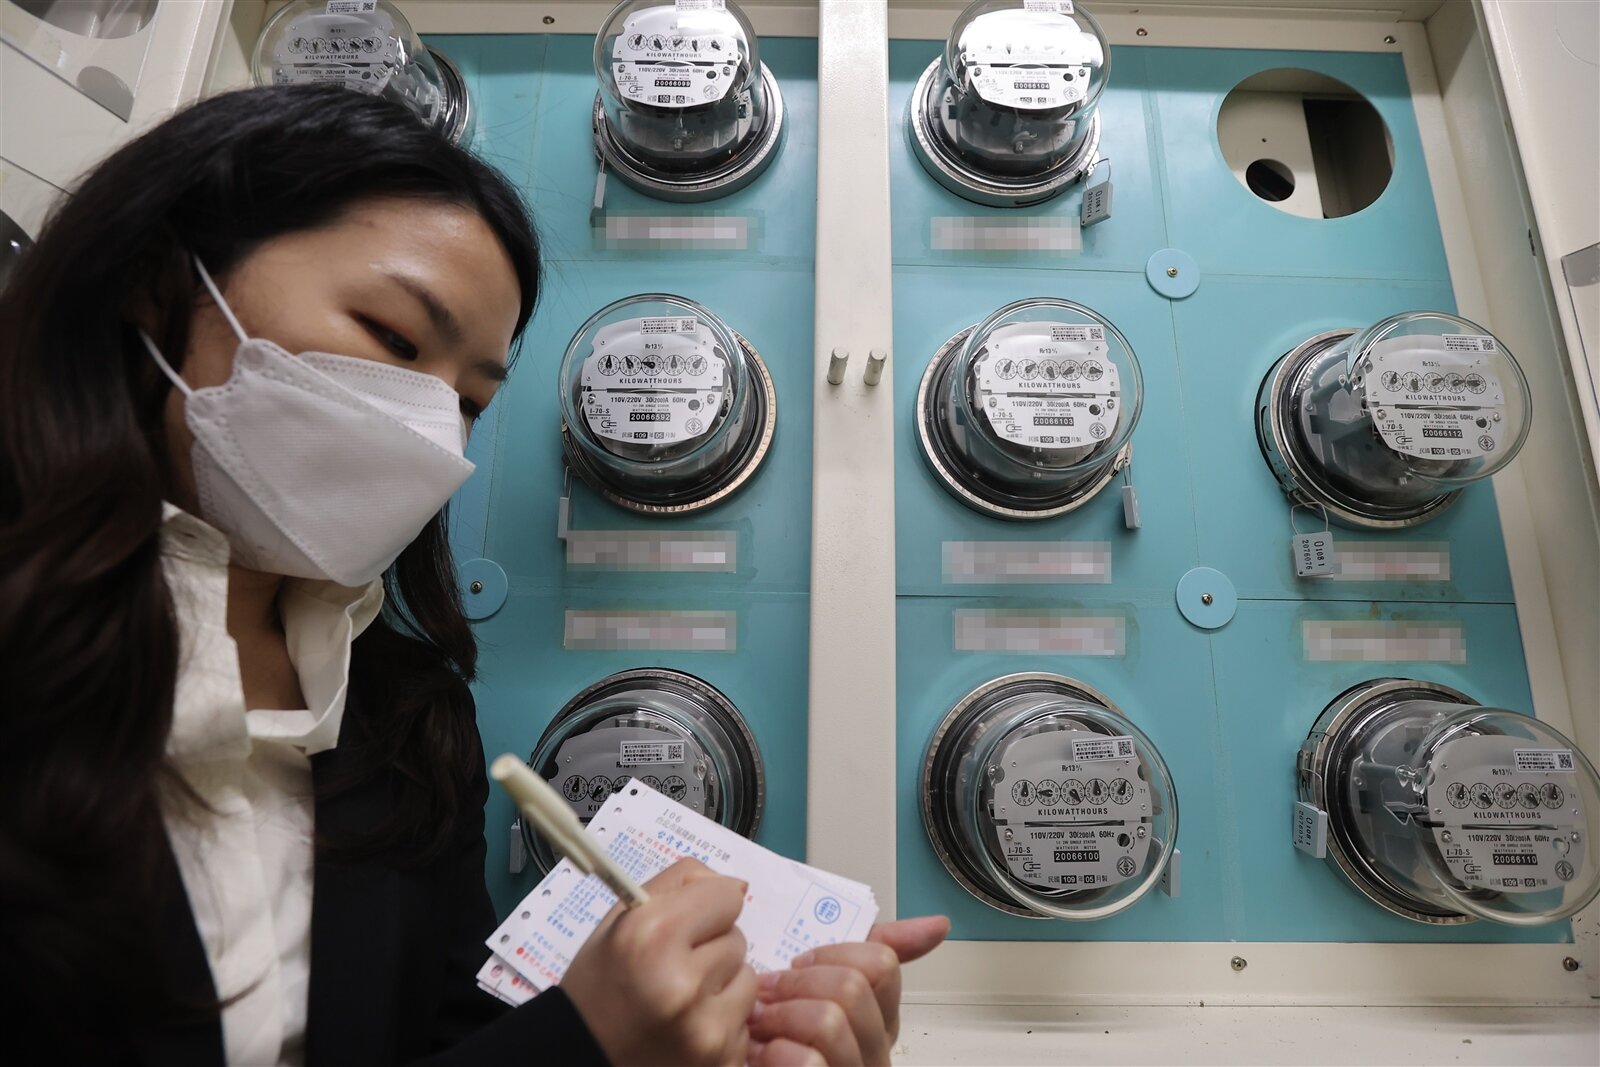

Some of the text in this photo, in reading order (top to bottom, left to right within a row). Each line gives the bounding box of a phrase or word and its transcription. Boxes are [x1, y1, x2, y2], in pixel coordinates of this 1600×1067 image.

[630, 412, 670, 421] 20066592
[1423, 428, 1463, 438] 20066112
[1302, 540, 1312, 570] 2076076
[662, 808, 682, 822] 106
[1054, 850, 1100, 862] 20066100
[1493, 854, 1538, 865] 20066110
[1061, 875, 1077, 884] 109
